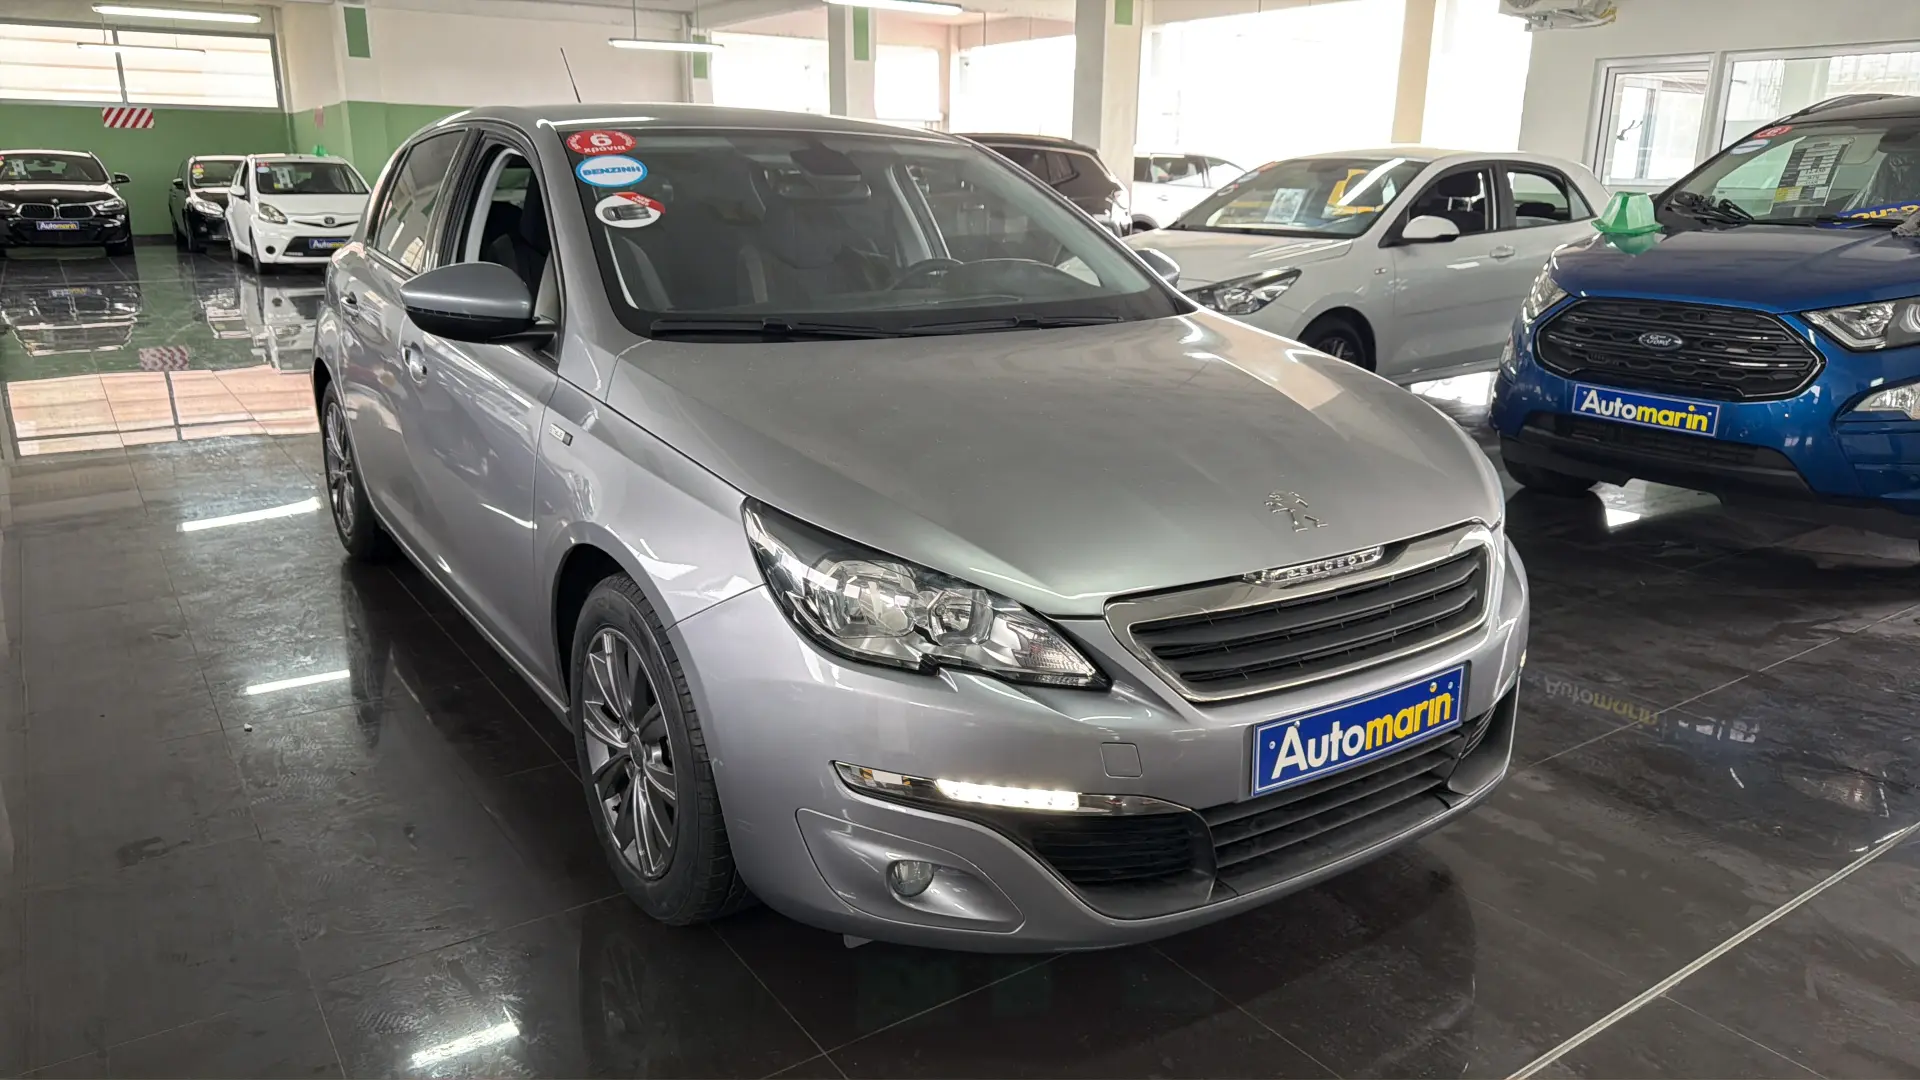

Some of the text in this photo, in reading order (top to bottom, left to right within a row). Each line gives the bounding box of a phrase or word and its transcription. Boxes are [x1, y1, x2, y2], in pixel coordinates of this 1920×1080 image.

[590, 133, 612, 147] 6
[1580, 389, 1708, 432] Automarin
[1287, 554, 1367, 577] PEUGEOT
[1271, 682, 1452, 780] Automarin
